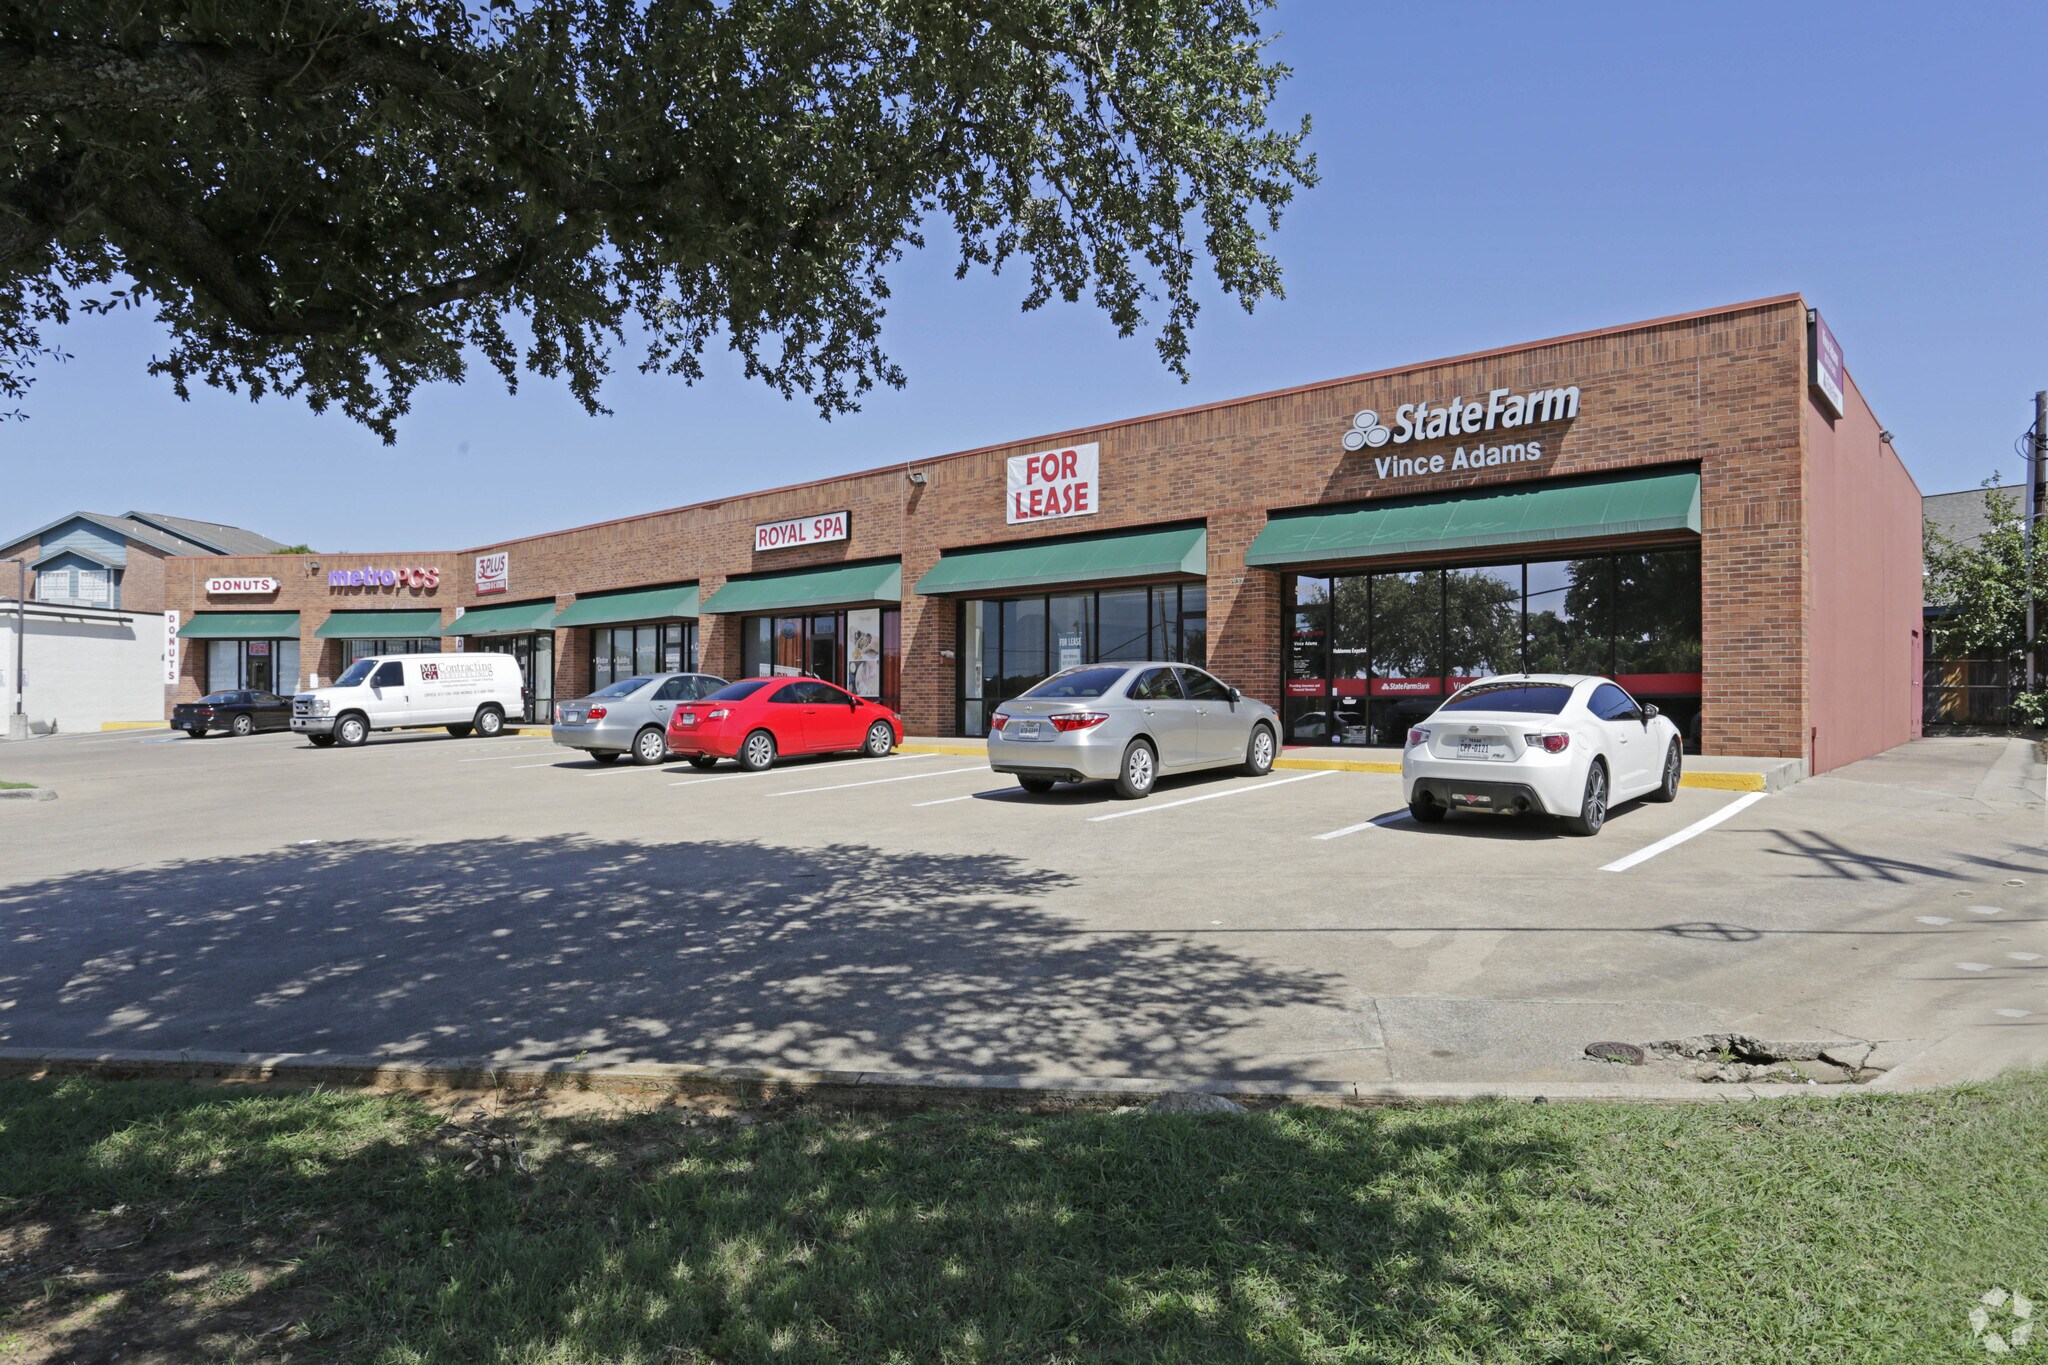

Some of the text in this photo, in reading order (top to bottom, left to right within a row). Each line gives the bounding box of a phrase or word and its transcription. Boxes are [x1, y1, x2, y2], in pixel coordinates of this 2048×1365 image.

[1026, 450, 1078, 486] FOR
[1375, 441, 1542, 480] Vince Adams
[1015, 482, 1089, 520] LEASE
[759, 516, 844, 548] ROYAL SPA
[212, 579, 270, 591] DONUTS
[328, 566, 441, 589] metroPCS
[168, 615, 176, 680] DONUTS
[1059, 637, 1082, 647] FOR LEASE
[438, 661, 494, 676] Contracting
[1460, 743, 1489, 754] CPP-0121
